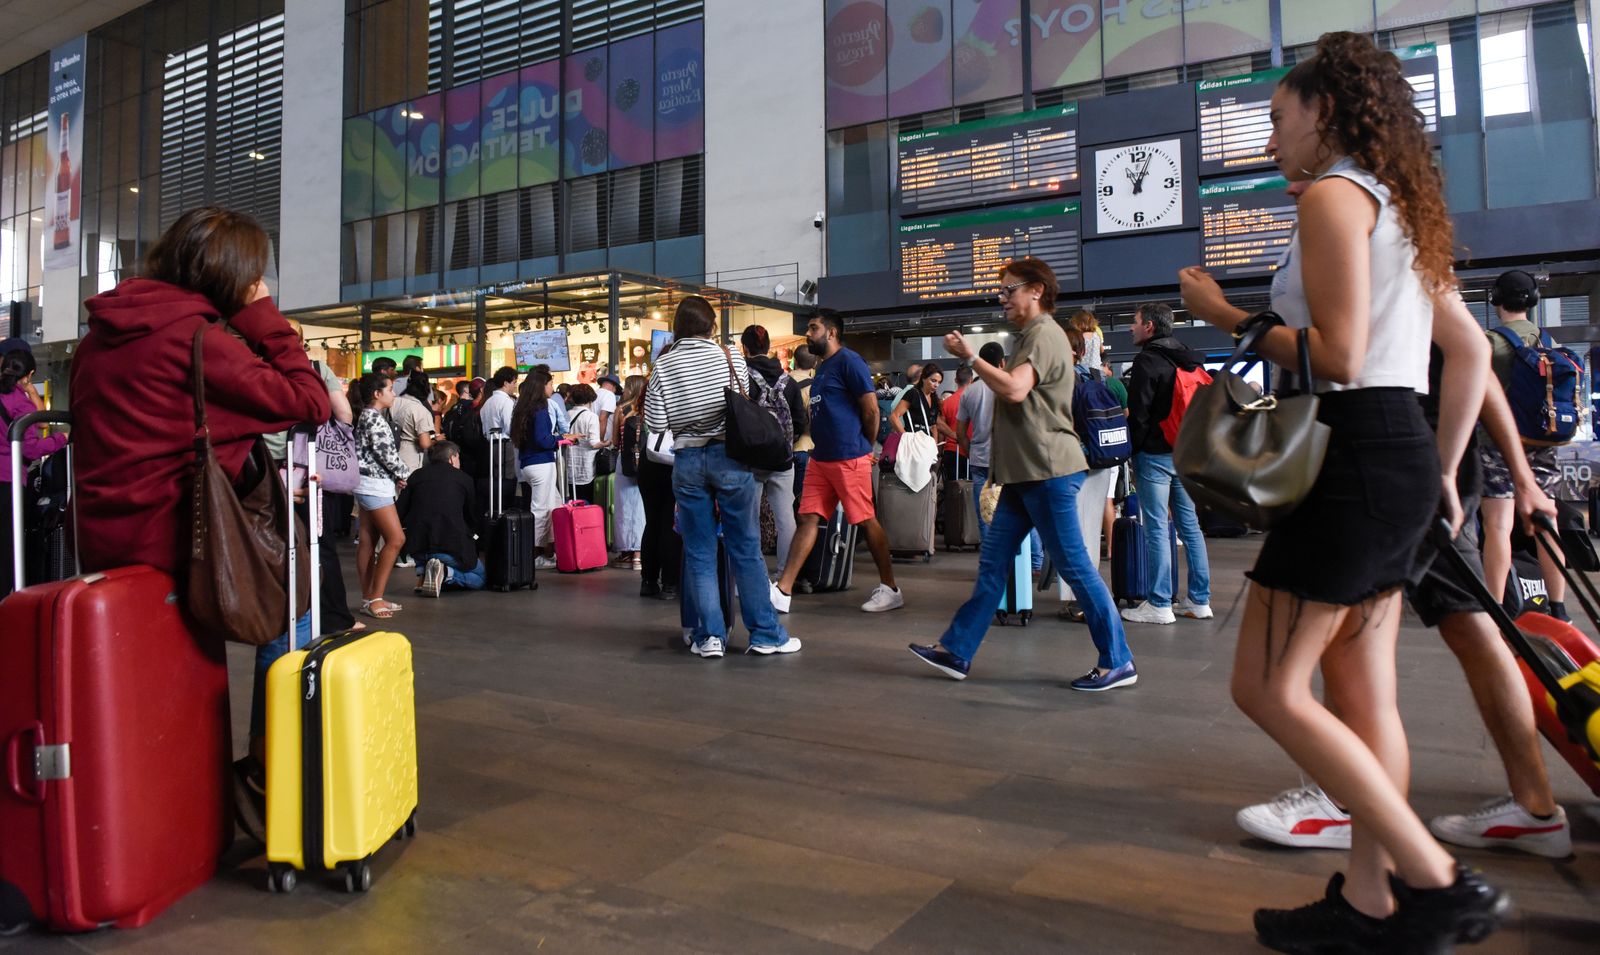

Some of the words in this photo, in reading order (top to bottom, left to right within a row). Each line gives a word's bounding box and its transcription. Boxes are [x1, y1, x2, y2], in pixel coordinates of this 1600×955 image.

[1200, 79, 1222, 91] Salidas
[900, 132, 922, 144] Llegadas
[1129, 151, 1147, 164] 12
[1163, 178, 1175, 189] 3
[1102, 185, 1114, 197] 9
[1201, 185, 1225, 195] Salidas
[1133, 211, 1145, 223] 6
[900, 223, 923, 233] Llegadas
[1101, 429, 1127, 444] PUMA
[1563, 464, 1592, 482] RO
